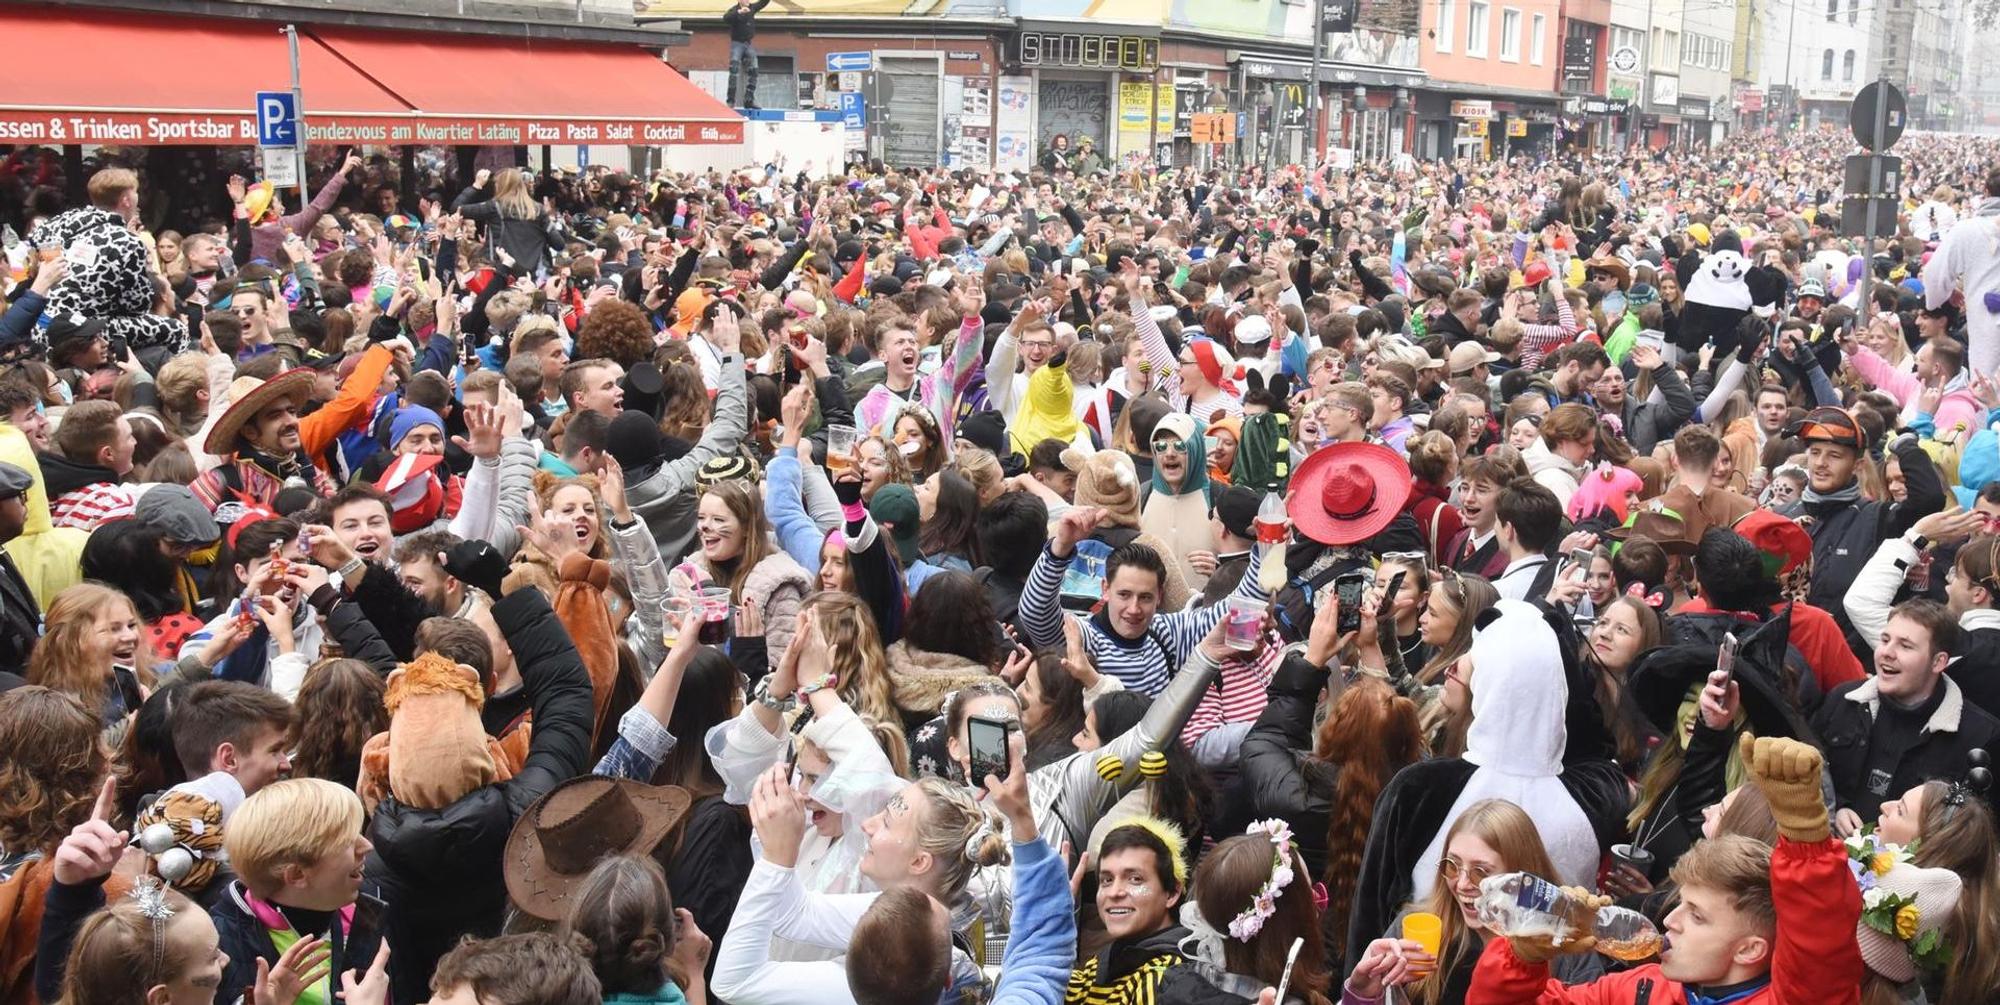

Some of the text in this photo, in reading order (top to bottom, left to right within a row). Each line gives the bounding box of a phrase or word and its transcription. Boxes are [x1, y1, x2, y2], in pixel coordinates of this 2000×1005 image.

[844, 94, 855, 110] P
[262, 98, 285, 139] P
[1461, 107, 1487, 116] KIOSK
[50, 118, 65, 139] &
[70, 118, 142, 139] Trinken
[148, 118, 235, 142] Sportsbar
[391, 127, 411, 140] am
[416, 122, 473, 140] Kwartier
[478, 123, 520, 142] Latäng
[528, 123, 685, 140] Pizza Pasta Salat Cocktail
